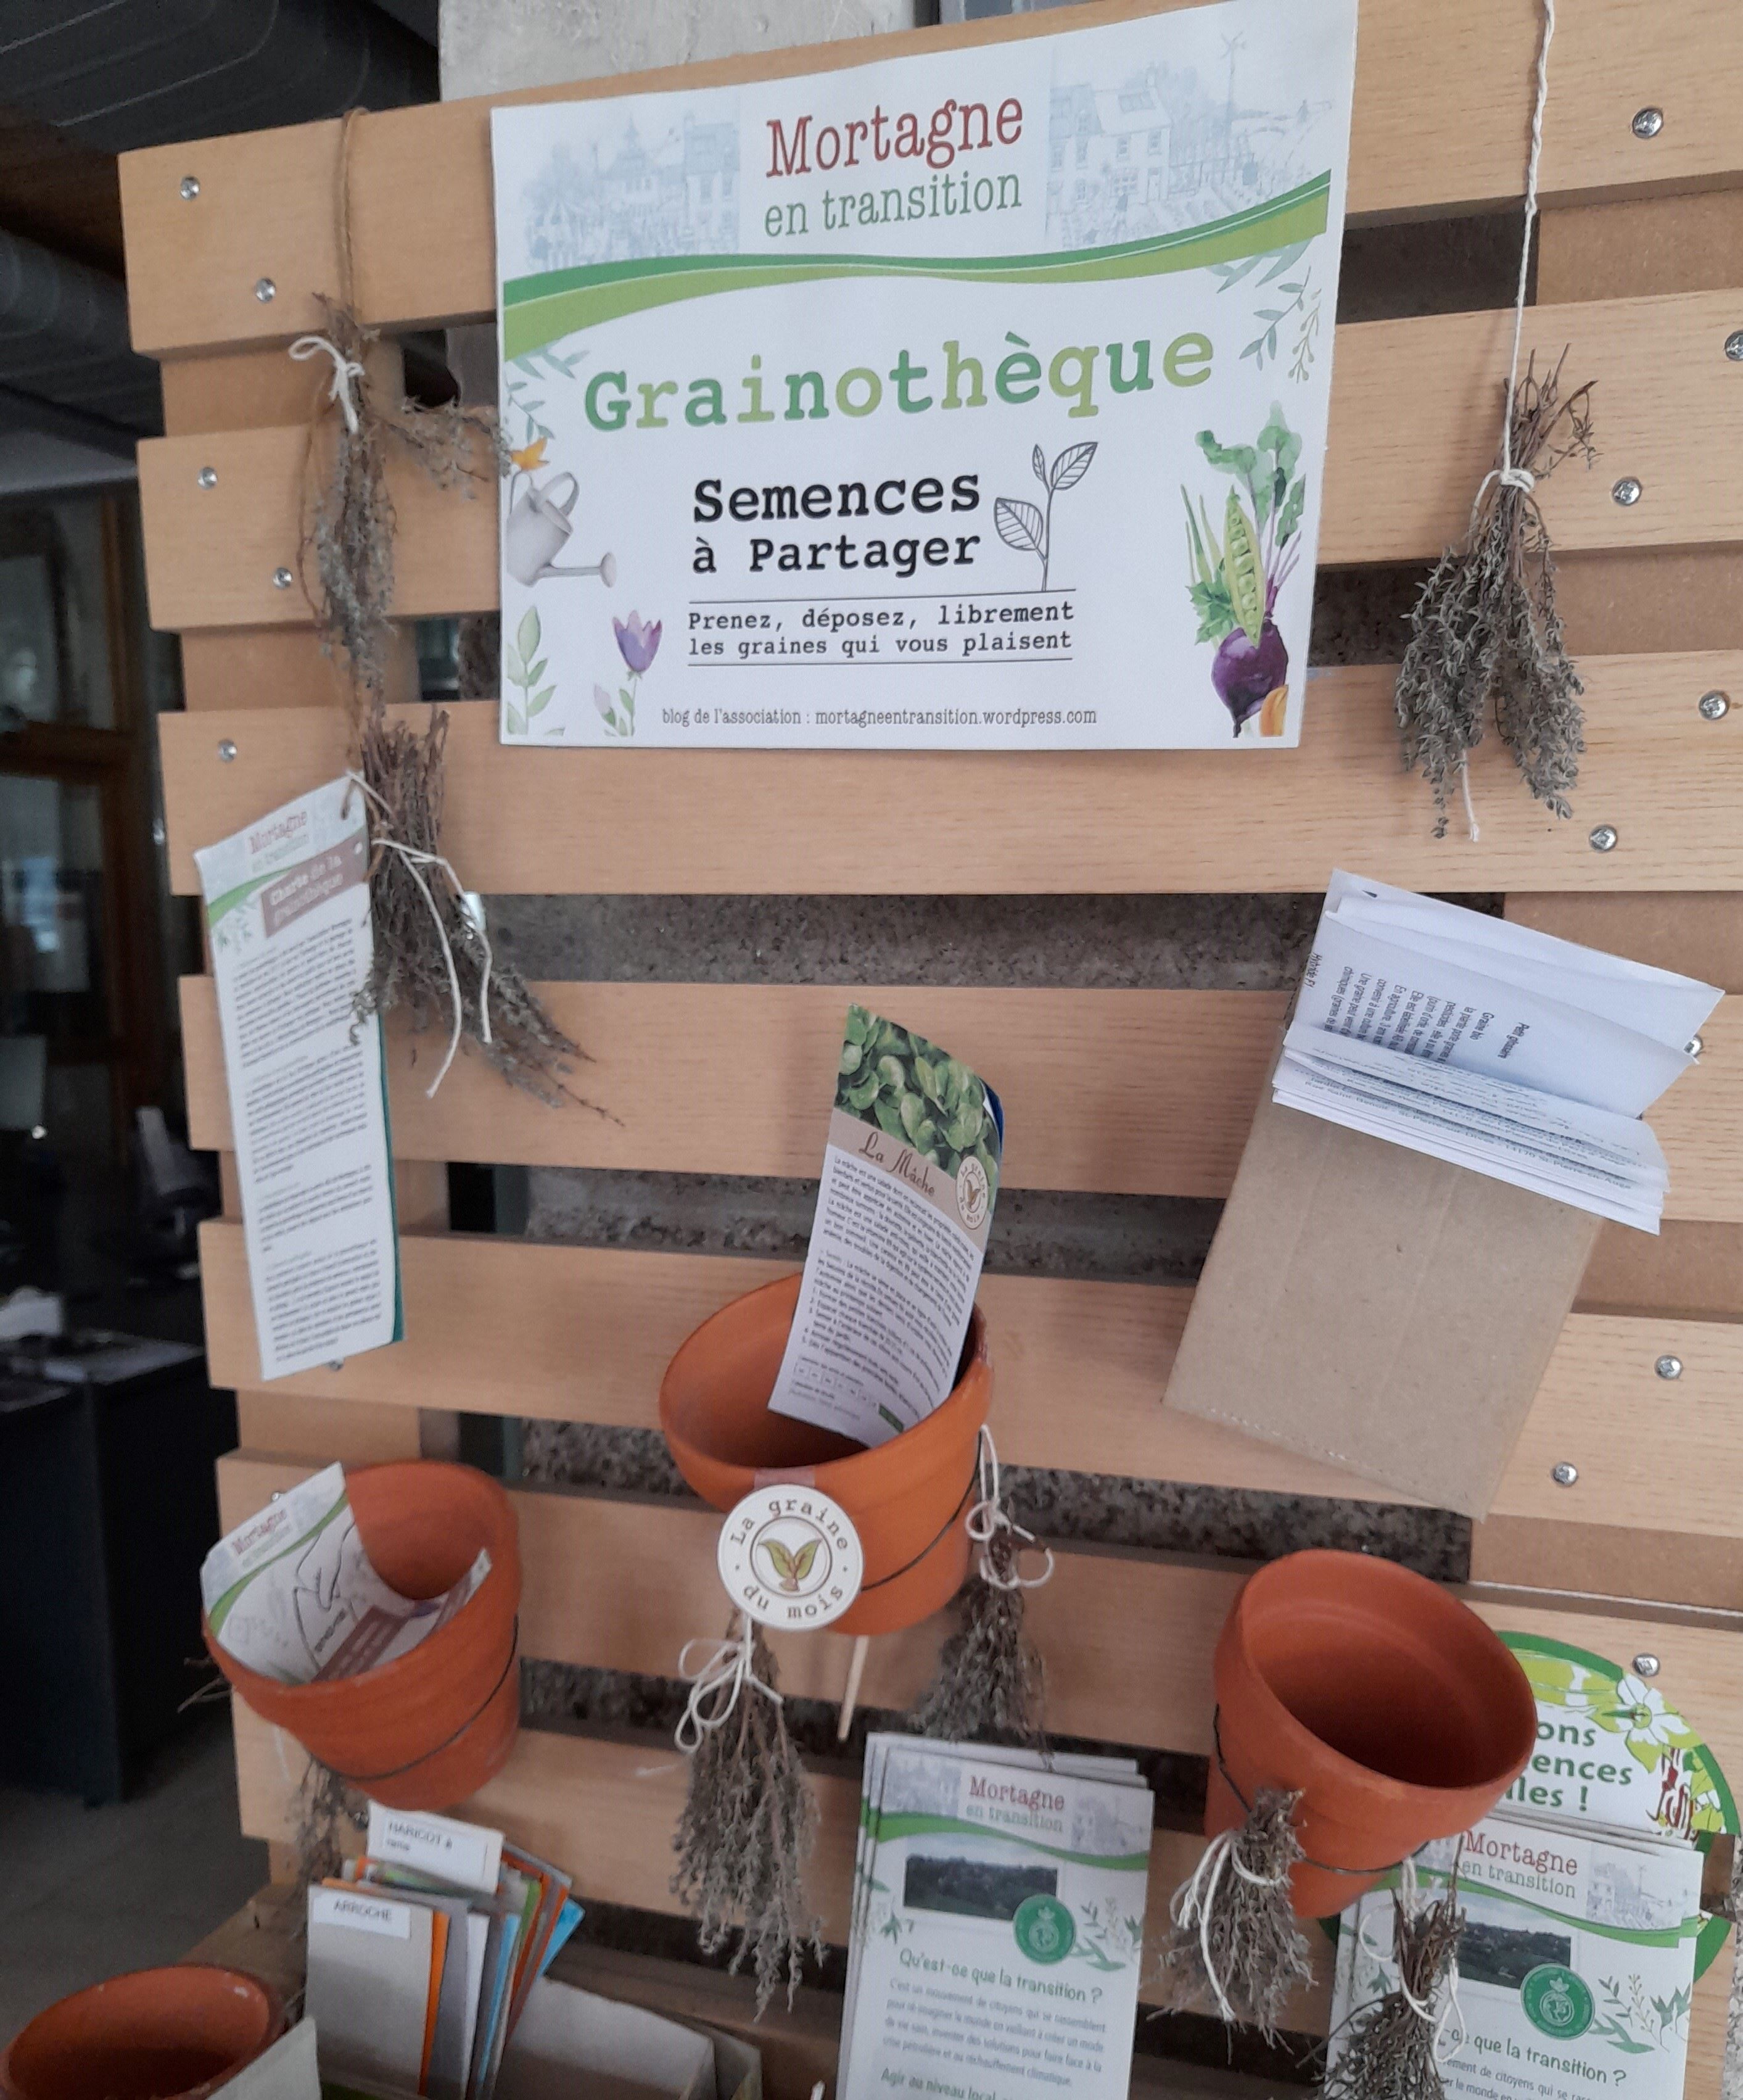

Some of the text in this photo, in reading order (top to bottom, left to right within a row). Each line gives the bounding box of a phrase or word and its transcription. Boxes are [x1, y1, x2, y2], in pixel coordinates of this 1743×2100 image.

[767, 98, 1023, 178] Mortagne
[766, 171, 1023, 238] en transition
[584, 331, 1215, 431] Grainothèque
[694, 474, 980, 524] Semences
[693, 534, 981, 579] à Partager
[690, 601, 1074, 632] Prenez, déposez, librement
[690, 631, 1072, 660] les graines qui vous plaisent
[664, 709, 1097, 729] blog de l'association : mortagneentransition.wordpress.com
[1349, 983, 1367, 1005] graine
[1358, 972, 1372, 986] Une
[1393, 984, 1407, 995] En
[1346, 1002, 1359, 1017] peut
[1405, 1001, 1416, 1012] est
[1409, 990, 1424, 1003] Elle
[1469, 1011, 1495, 1041] Graine bio
[858, 1131, 935, 1196] La Mâche
[731, 1499, 848, 1550] La graine
[743, 1585, 843, 1619] du mois
[1536, 1721, 1596, 1747] ons
[1531, 1754, 1633, 1785] ences
[970, 1775, 1065, 1811] Mortagne
[1505, 1774, 1588, 1811] lles !
[966, 1805, 1062, 1833] en transition
[1464, 1829, 1578, 1875] Mortagne
[1462, 1861, 1575, 1898] en transition
[899, 1947, 1103, 2003] Qu'est-ce que la transition ?
[881, 2067, 905, 2087] Agir
[1474, 2036, 1626, 2086] que la transition ?
[1446, 2060, 1477, 2073] ement
[1480, 2065, 1491, 2078] de
[1496, 2072, 1534, 2090] citoyens
[1538, 2083, 1553, 2096] qui
[1557, 2089, 1567, 2100] se
[1456, 2078, 1464, 2090] le
[1466, 2084, 1499, 2099] monde
